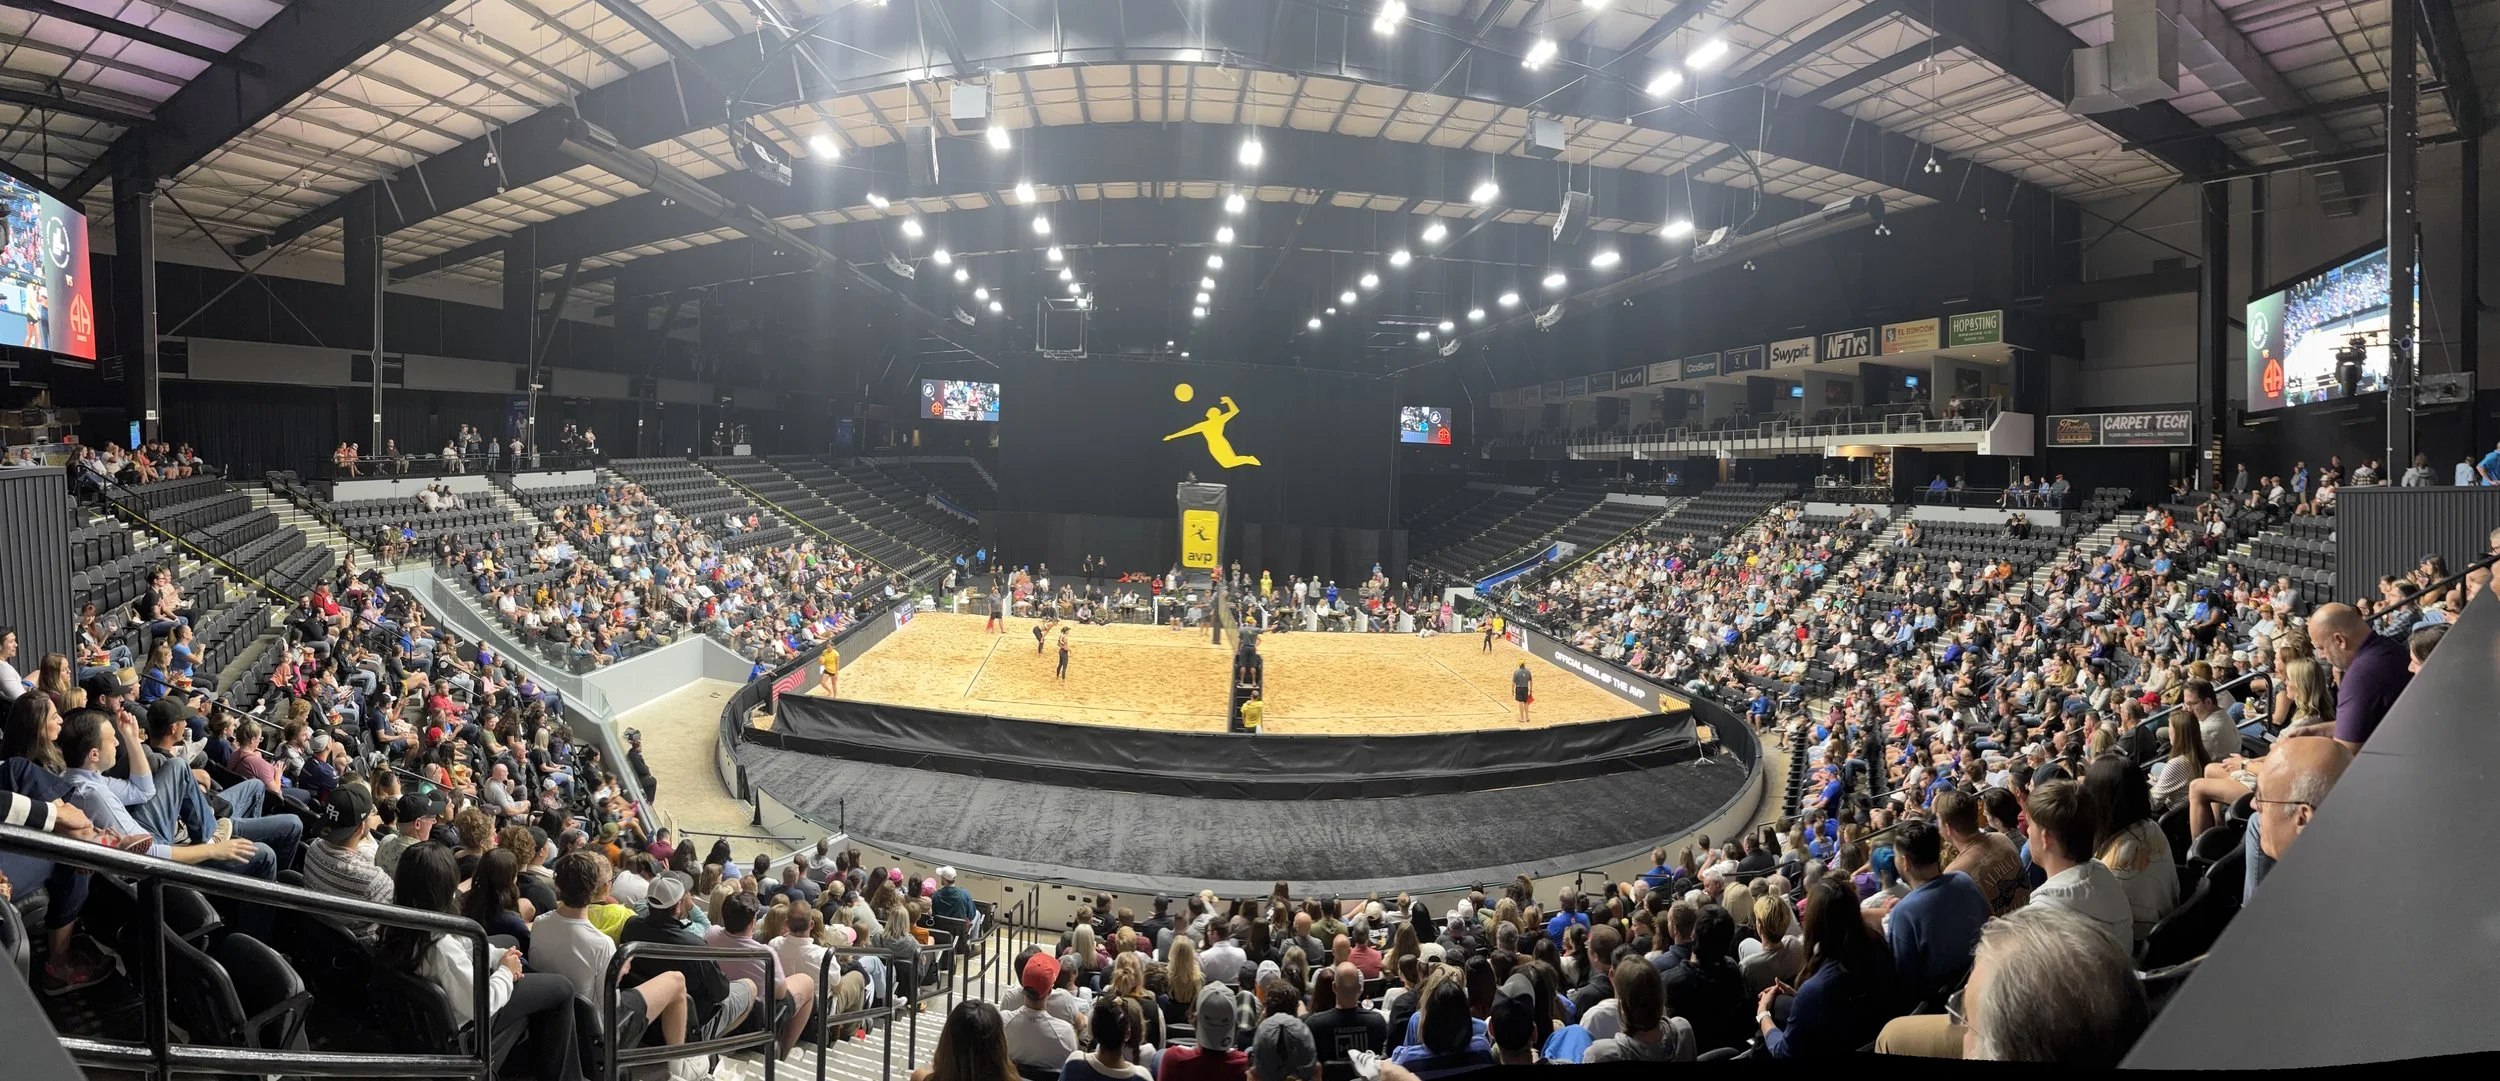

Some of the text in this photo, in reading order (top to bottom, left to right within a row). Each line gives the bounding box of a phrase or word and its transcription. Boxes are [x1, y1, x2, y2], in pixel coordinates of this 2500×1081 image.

[1953, 315, 1997, 333] HOP&STING
[1772, 344, 1810, 363] Swypit
[1826, 333, 1868, 359] NFTYS
[2104, 414, 2189, 430] CARPET TECH
[1187, 551, 1213, 564] avp
[1554, 651, 1582, 671] OFFICIAL
[1613, 677, 1628, 693] THE
[1629, 685, 1646, 699] AVP
